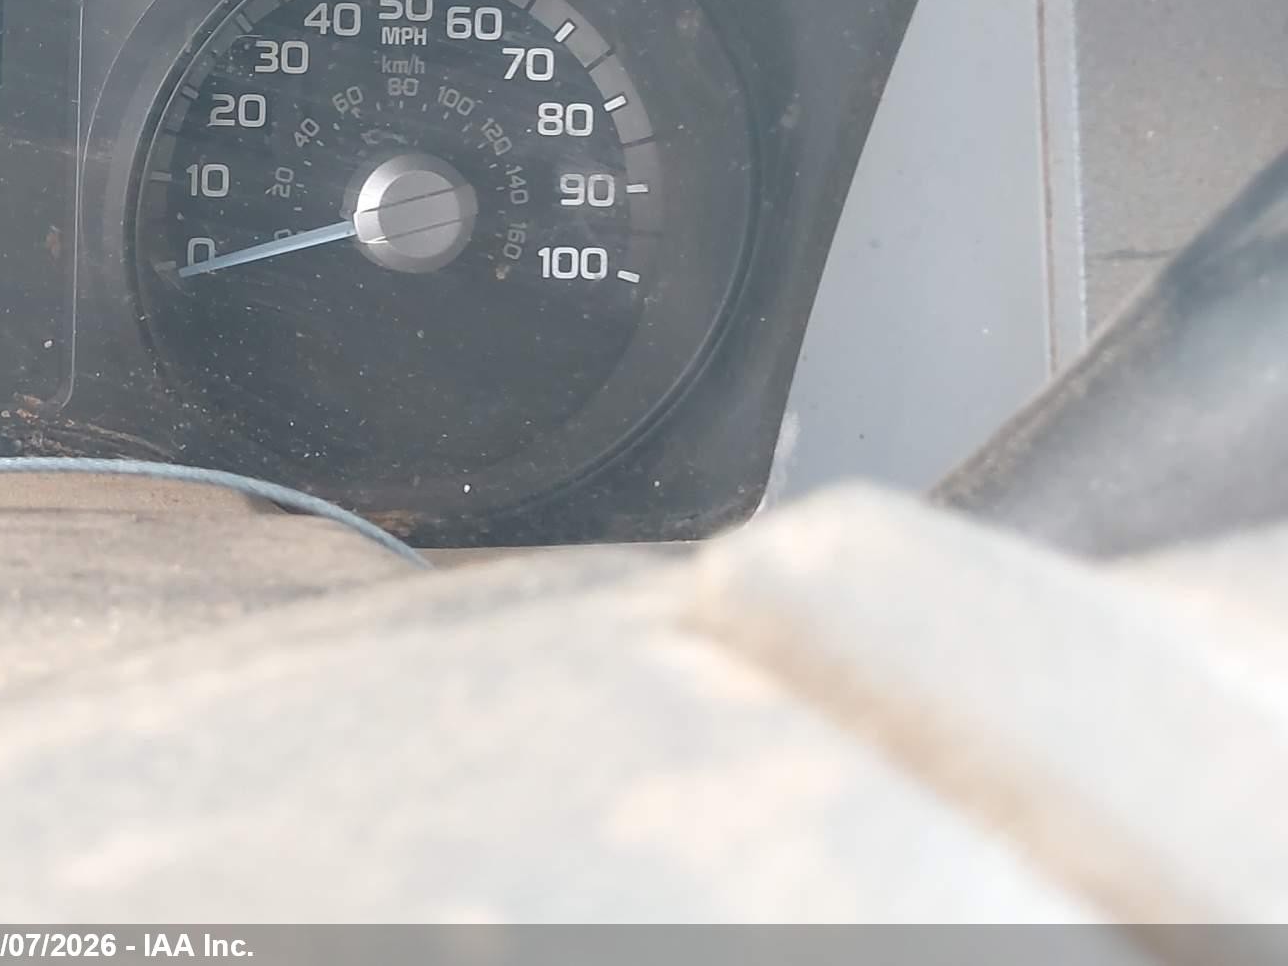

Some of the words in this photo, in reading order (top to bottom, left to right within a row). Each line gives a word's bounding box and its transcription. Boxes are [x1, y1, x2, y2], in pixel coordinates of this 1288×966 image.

[304, 3, 361, 36] 40
[446, 6, 502, 40] 60
[381, 28, 427, 45] MPH
[254, 40, 309, 74] 30
[381, 56, 425, 75] km/h
[502, 48, 555, 81] 70
[332, 86, 362, 113] 60
[388, 78, 419, 97] 80
[437, 86, 474, 116] 100
[209, 94, 266, 128] 20
[537, 103, 594, 136] 80
[294, 118, 320, 147] 40
[481, 118, 512, 156] 120
[186, 164, 229, 197] 10
[272, 167, 294, 198] 20
[506, 165, 529, 204] 140
[560, 174, 615, 207] 90
[187, 238, 216, 273] 0
[504, 222, 526, 260] 160
[537, 247, 608, 279] 100
